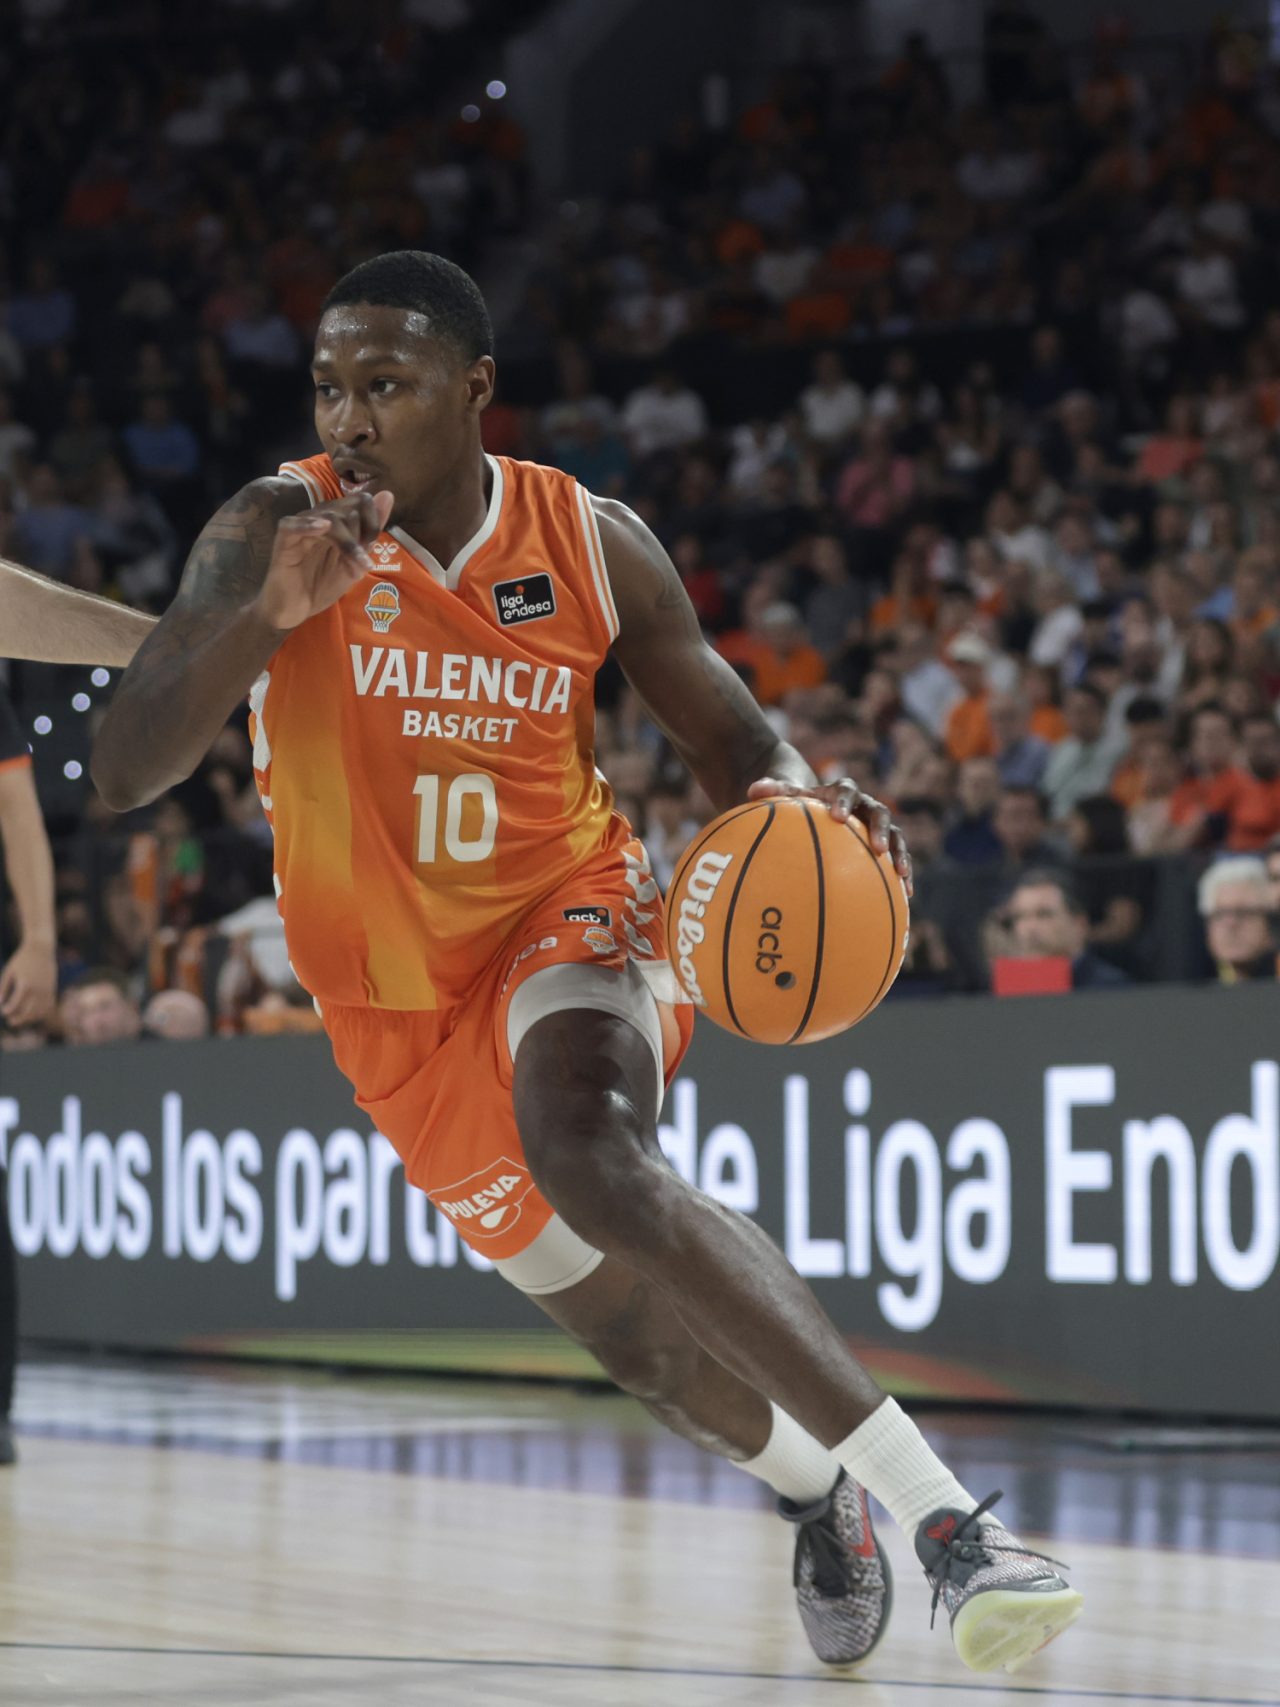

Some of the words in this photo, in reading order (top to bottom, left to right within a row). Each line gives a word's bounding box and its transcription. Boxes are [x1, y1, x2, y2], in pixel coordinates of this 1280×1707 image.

[501, 594, 524, 609] liga
[503, 601, 551, 620] endesa
[349, 644, 572, 714] VALENCIA
[402, 709, 519, 743] BASKET
[412, 773, 499, 863] 10
[568, 912, 601, 924] acb
[755, 907, 783, 974] acb
[162, 1090, 264, 1264] los
[783, 1067, 1012, 1332] Liga
[1043, 1058, 1280, 1291] End
[440, 1175, 521, 1220] PULEVA
